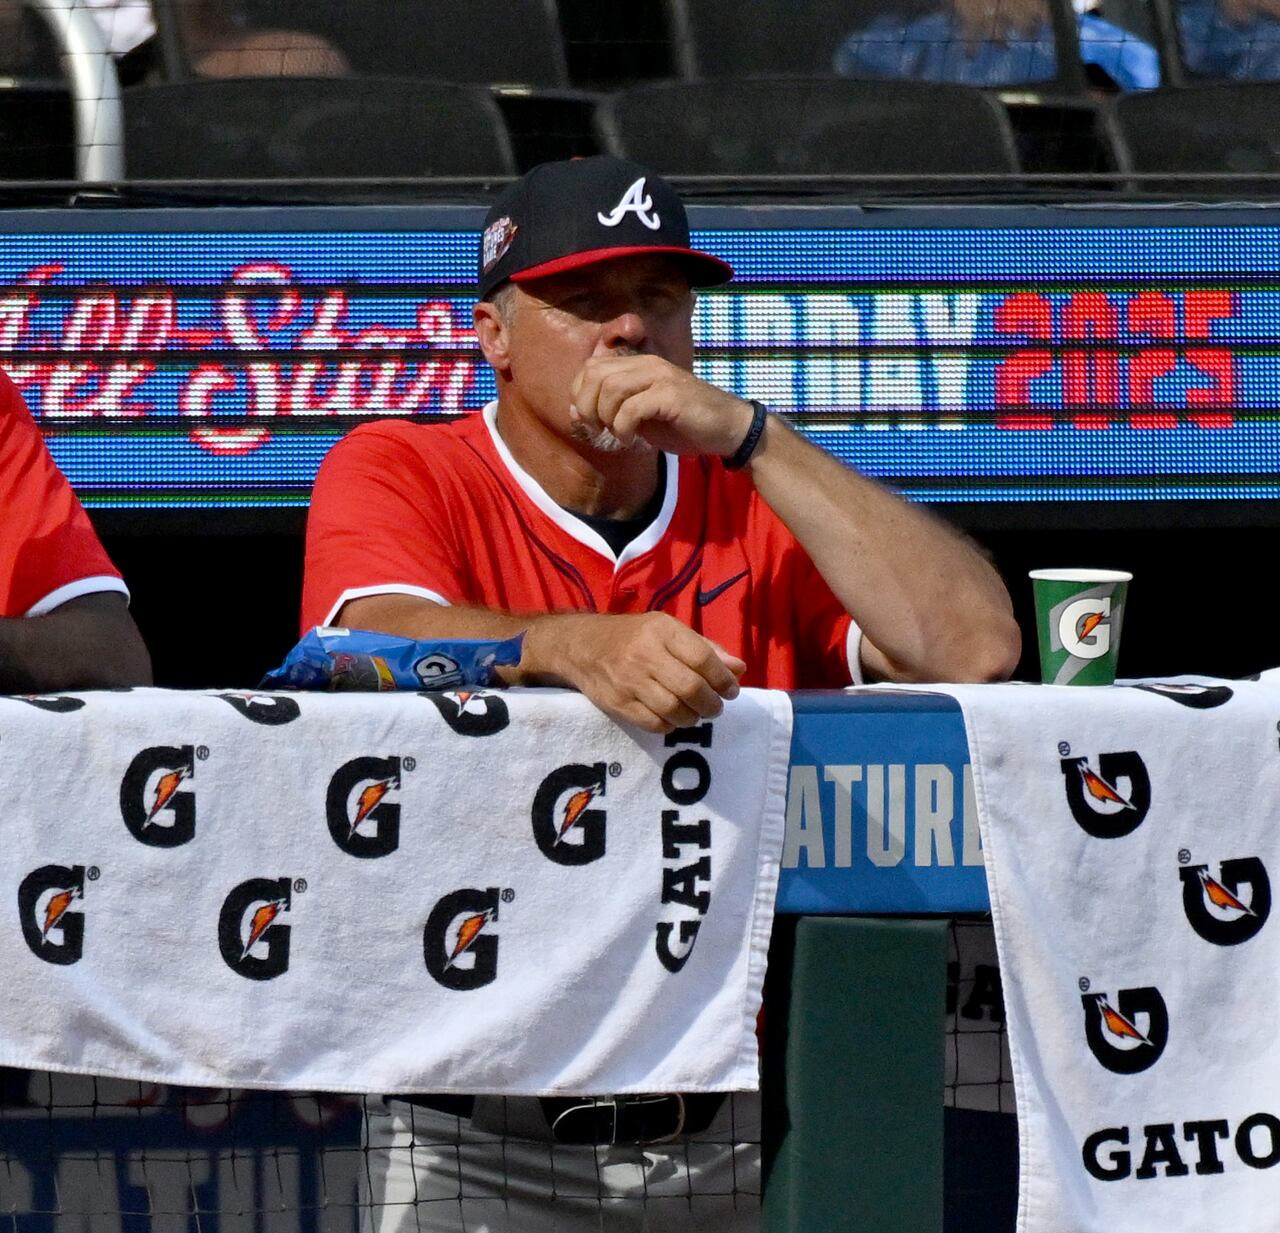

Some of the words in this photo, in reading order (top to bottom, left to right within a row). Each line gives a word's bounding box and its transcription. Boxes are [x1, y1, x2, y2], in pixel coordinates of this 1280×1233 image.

[597, 177, 661, 230] A
[1059, 599, 1112, 659] G
[121, 745, 197, 848] G
[326, 756, 401, 858] G
[532, 762, 607, 866] G
[1061, 750, 1151, 839] G
[18, 864, 86, 965] G
[219, 877, 292, 981] G
[423, 888, 500, 991] G
[1179, 856, 1271, 946] G
[1081, 986, 1169, 1074] G
